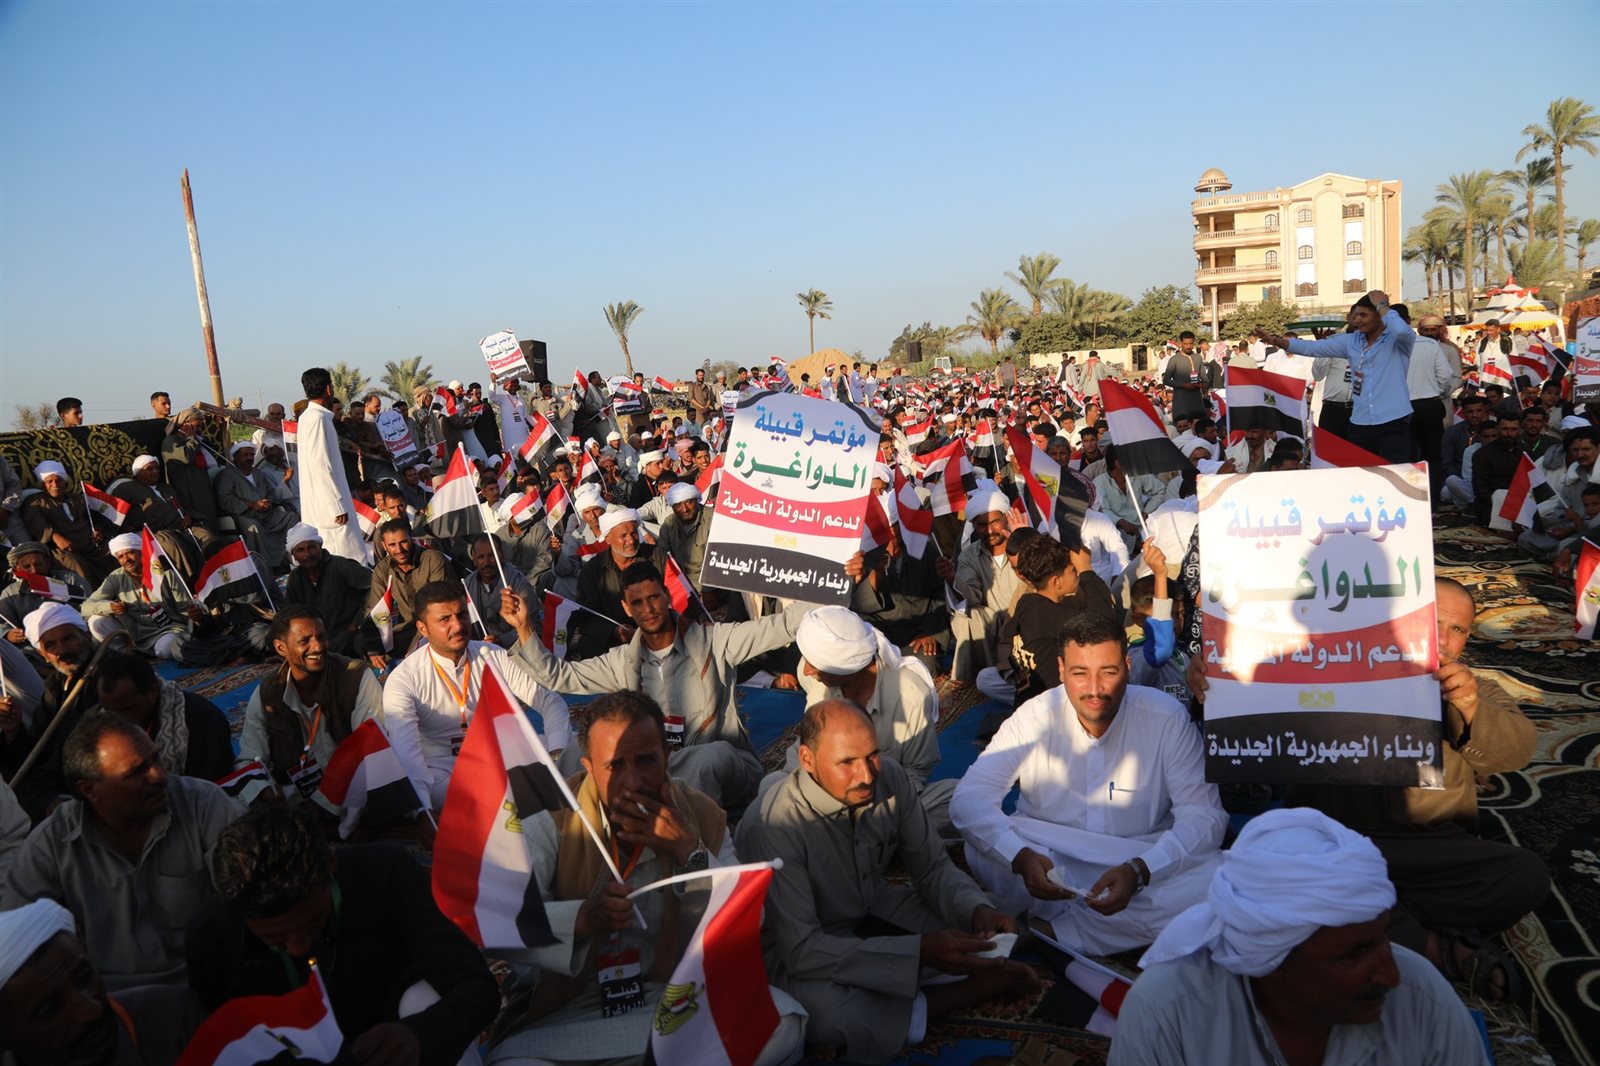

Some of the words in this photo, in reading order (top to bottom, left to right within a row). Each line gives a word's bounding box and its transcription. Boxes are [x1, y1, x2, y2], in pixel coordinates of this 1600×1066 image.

[754, 405, 803, 442] قبيلة
[804, 420, 866, 453] مؤتمر
[733, 441, 867, 490] الدواغرة
[722, 490, 773, 515] المصرية
[776, 500, 820, 524] الدولة
[822, 513, 861, 531] لدعم
[1223, 498, 1302, 549] قبيلة
[1308, 495, 1407, 546] مؤتمر
[709, 551, 758, 576] الجديدة
[759, 557, 817, 585] الجمهورية
[817, 571, 850, 595] وبناء
[1208, 555, 1422, 616] الدواغرة
[1288, 638, 1362, 670] الدولة
[1367, 638, 1429, 670] لدعم
[1206, 732, 1281, 766] الجديدة
[1284, 730, 1378, 767] الجمهورية
[1382, 733, 1436, 768] وبناء
[605, 982, 640, 999] قبيلة
